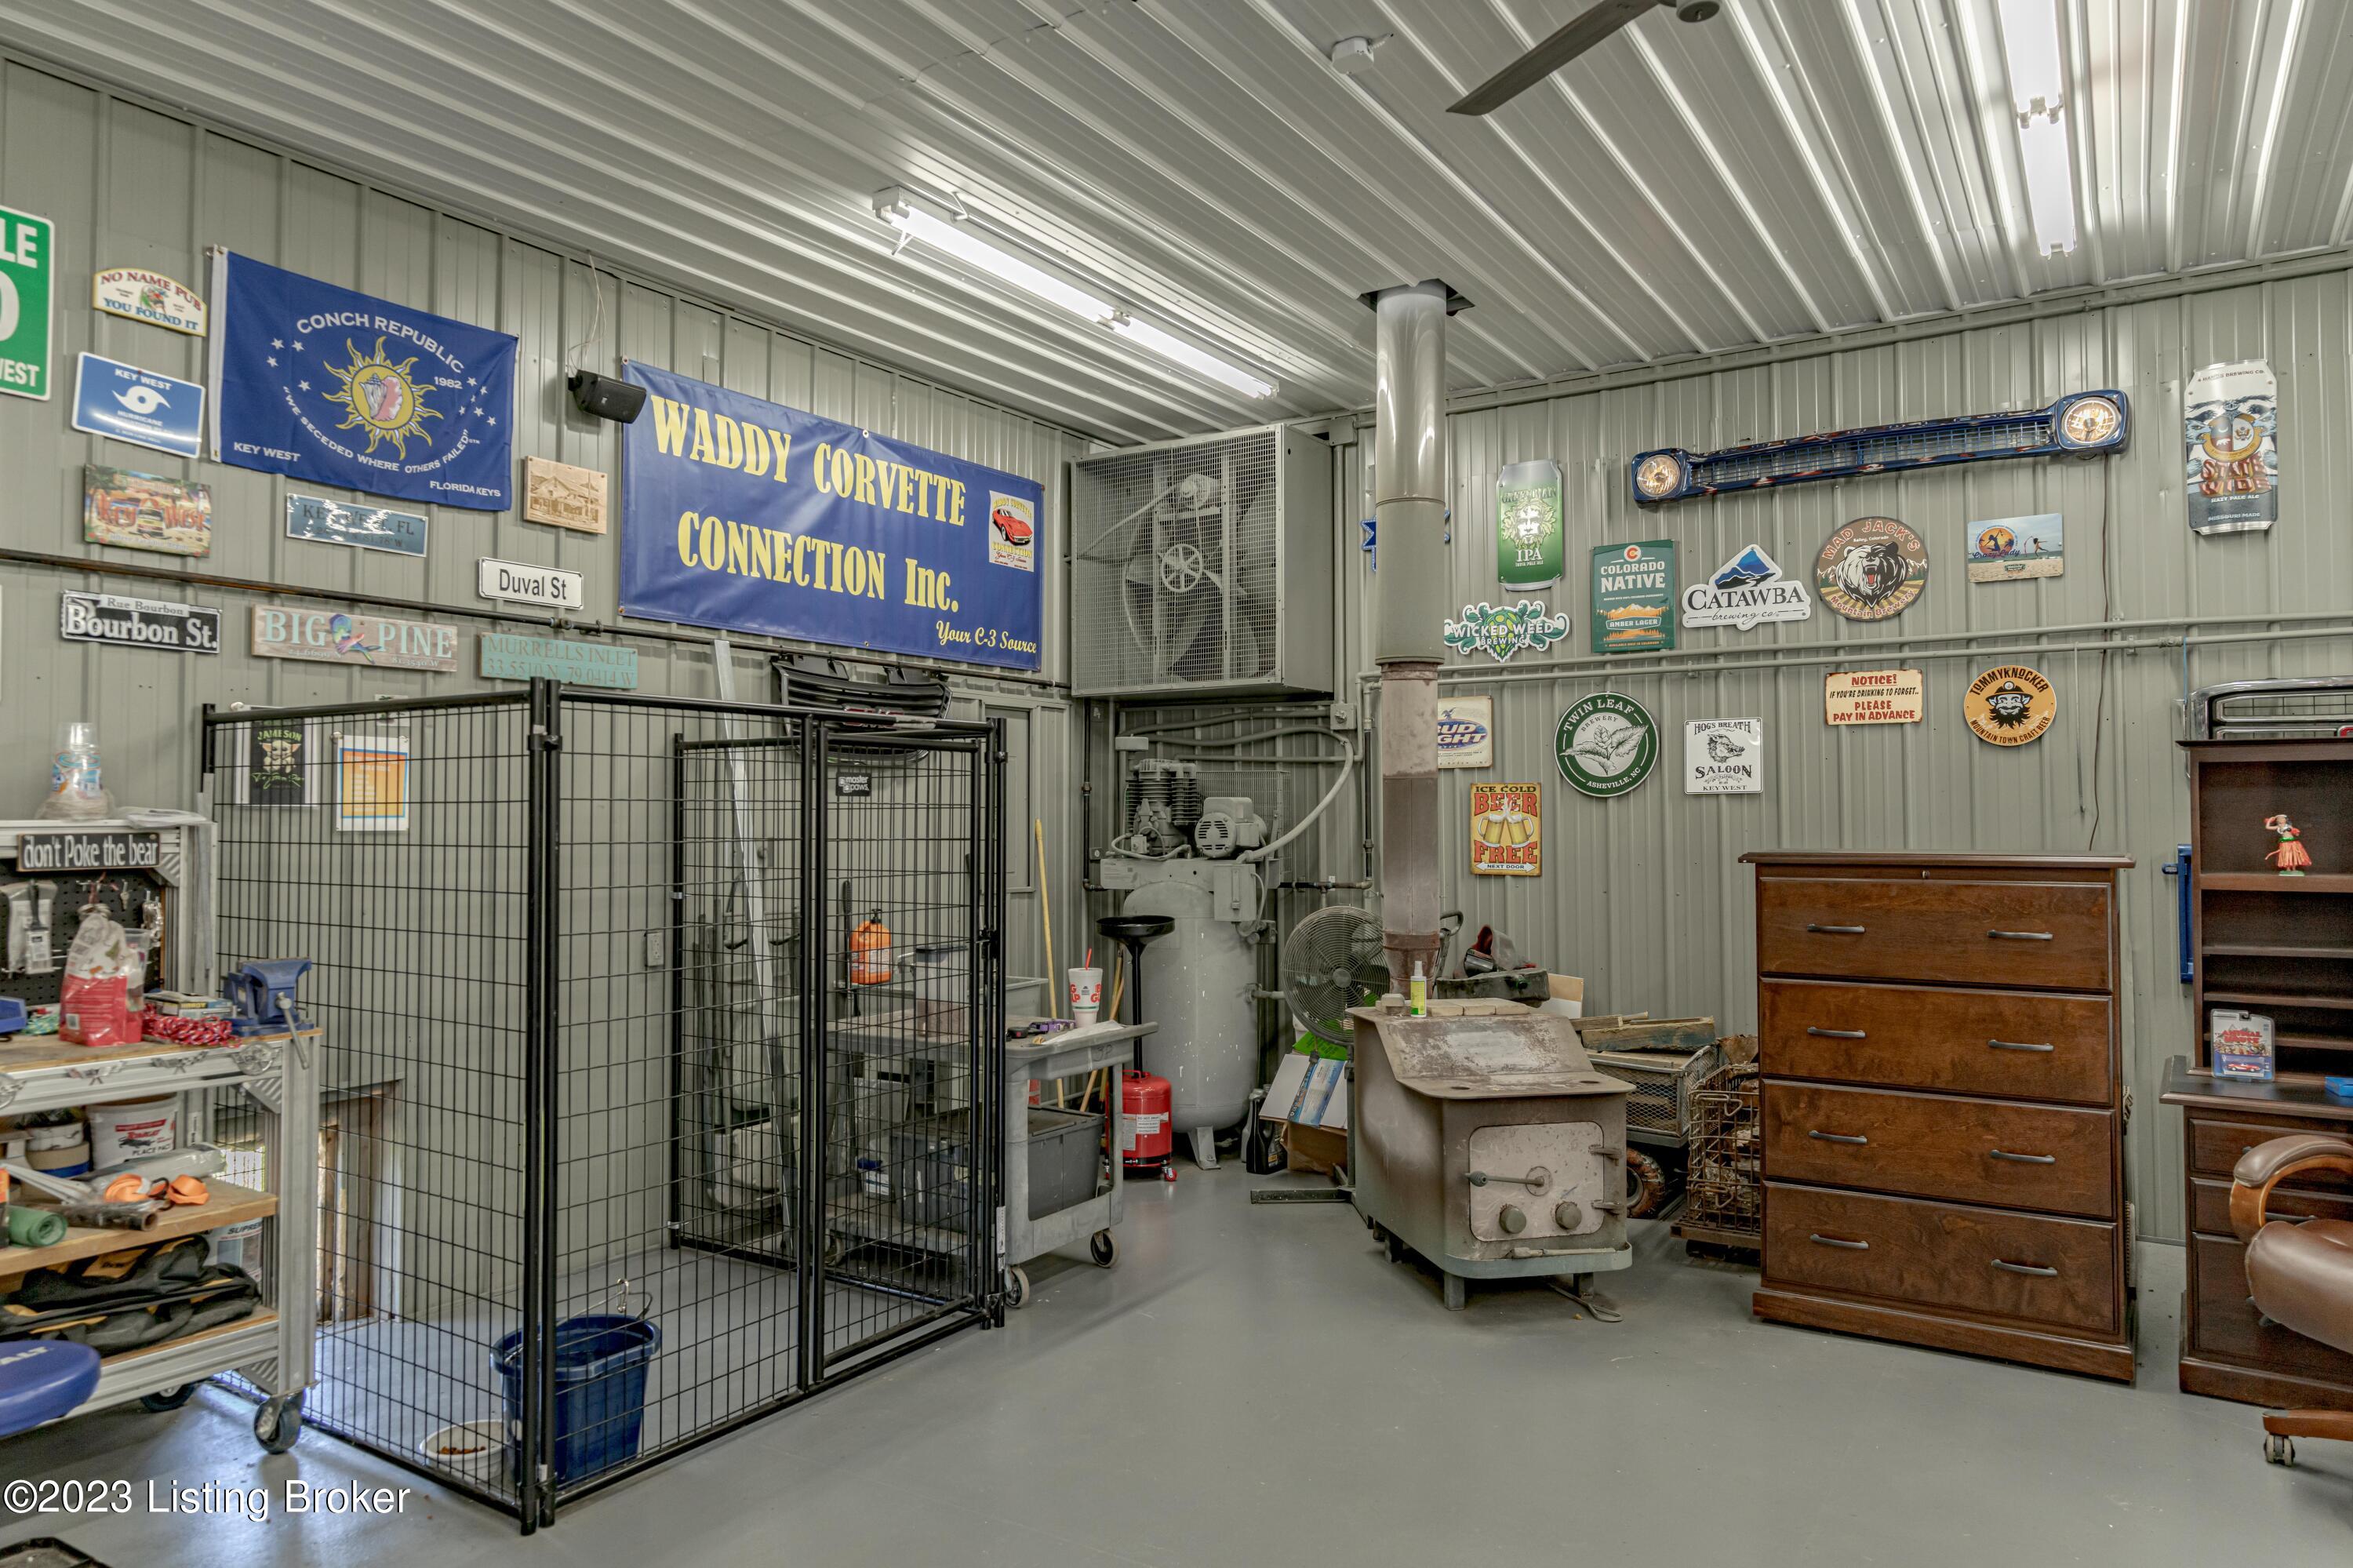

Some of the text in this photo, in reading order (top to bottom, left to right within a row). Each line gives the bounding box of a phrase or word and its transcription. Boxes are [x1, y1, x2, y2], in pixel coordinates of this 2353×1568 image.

[0, 217, 38, 268] LE
[101, 271, 123, 284] NO
[126, 271, 171, 291] NAME
[175, 286, 202, 311] PUB
[104, 297, 132, 312] YOU
[136, 306, 181, 326] FOUND
[185, 320, 198, 330] IT
[296, 311, 464, 373] CONCH REPUBLIC
[115, 368, 173, 391] KEY WEST
[434, 376, 463, 390] 1982
[234, 441, 301, 462] KEY WEST
[300, 416, 353, 458] SECEDED
[357, 453, 399, 471] WHERE
[404, 460, 440, 474] OTHERS
[650, 395, 966, 526] WADDY CORVETTE
[2201, 451, 2266, 480] STATE
[429, 480, 502, 497] FLORIDA KEYS
[2198, 477, 2271, 497] WIDE
[397, 520, 414, 536] FL
[1821, 520, 1920, 559] MAD JACK'S
[677, 510, 958, 613] CONNECTION Inc.
[1516, 549, 1543, 562] IPA
[1600, 561, 1665, 576] COLORADO
[499, 569, 566, 600] Duval St
[1600, 573, 1666, 593] NATIVE
[107, 598, 184, 615] Rue Bourbon
[1687, 586, 1805, 610] CATAWBA
[1831, 590, 1915, 617] Mountain Brewery
[66, 604, 217, 649] Bourbon St.
[1711, 608, 1756, 625] brewing
[264, 610, 453, 658] BIG PINE
[936, 620, 1037, 653] Your C-3 Source
[1453, 621, 1555, 638] WICKED WEED
[488, 636, 634, 667] MURRELLS INLET
[1480, 636, 1525, 646] BREWING
[547, 664, 558, 679] N
[621, 671, 634, 686] W
[1851, 674, 1897, 686] NOTICE!
[1969, 667, 2049, 696] TOMMYKNOCKER
[1857, 689, 1884, 697] DRINKING
[1886, 688, 1893, 697] TO
[1563, 698, 1635, 732] TWIN LEAF
[1833, 710, 1915, 722] PAY IN ADVANCE
[1854, 700, 1892, 711] PLEASE
[1581, 715, 1619, 732] BREWERY
[1718, 722, 1751, 734] BREATH
[1970, 719, 1998, 742] MOUNTAIN
[2019, 729, 2038, 742] CRAFT
[2036, 716, 2051, 731] BEER
[257, 729, 302, 742] JAMESON
[1438, 733, 1488, 744] GHT
[1587, 767, 1641, 789] ASHEVILLE, NC
[1695, 765, 1752, 779] SALOON
[1474, 792, 1538, 817] BEER
[24, 834, 158, 868] don't Poke the bear
[1474, 840, 1538, 864] FREE
